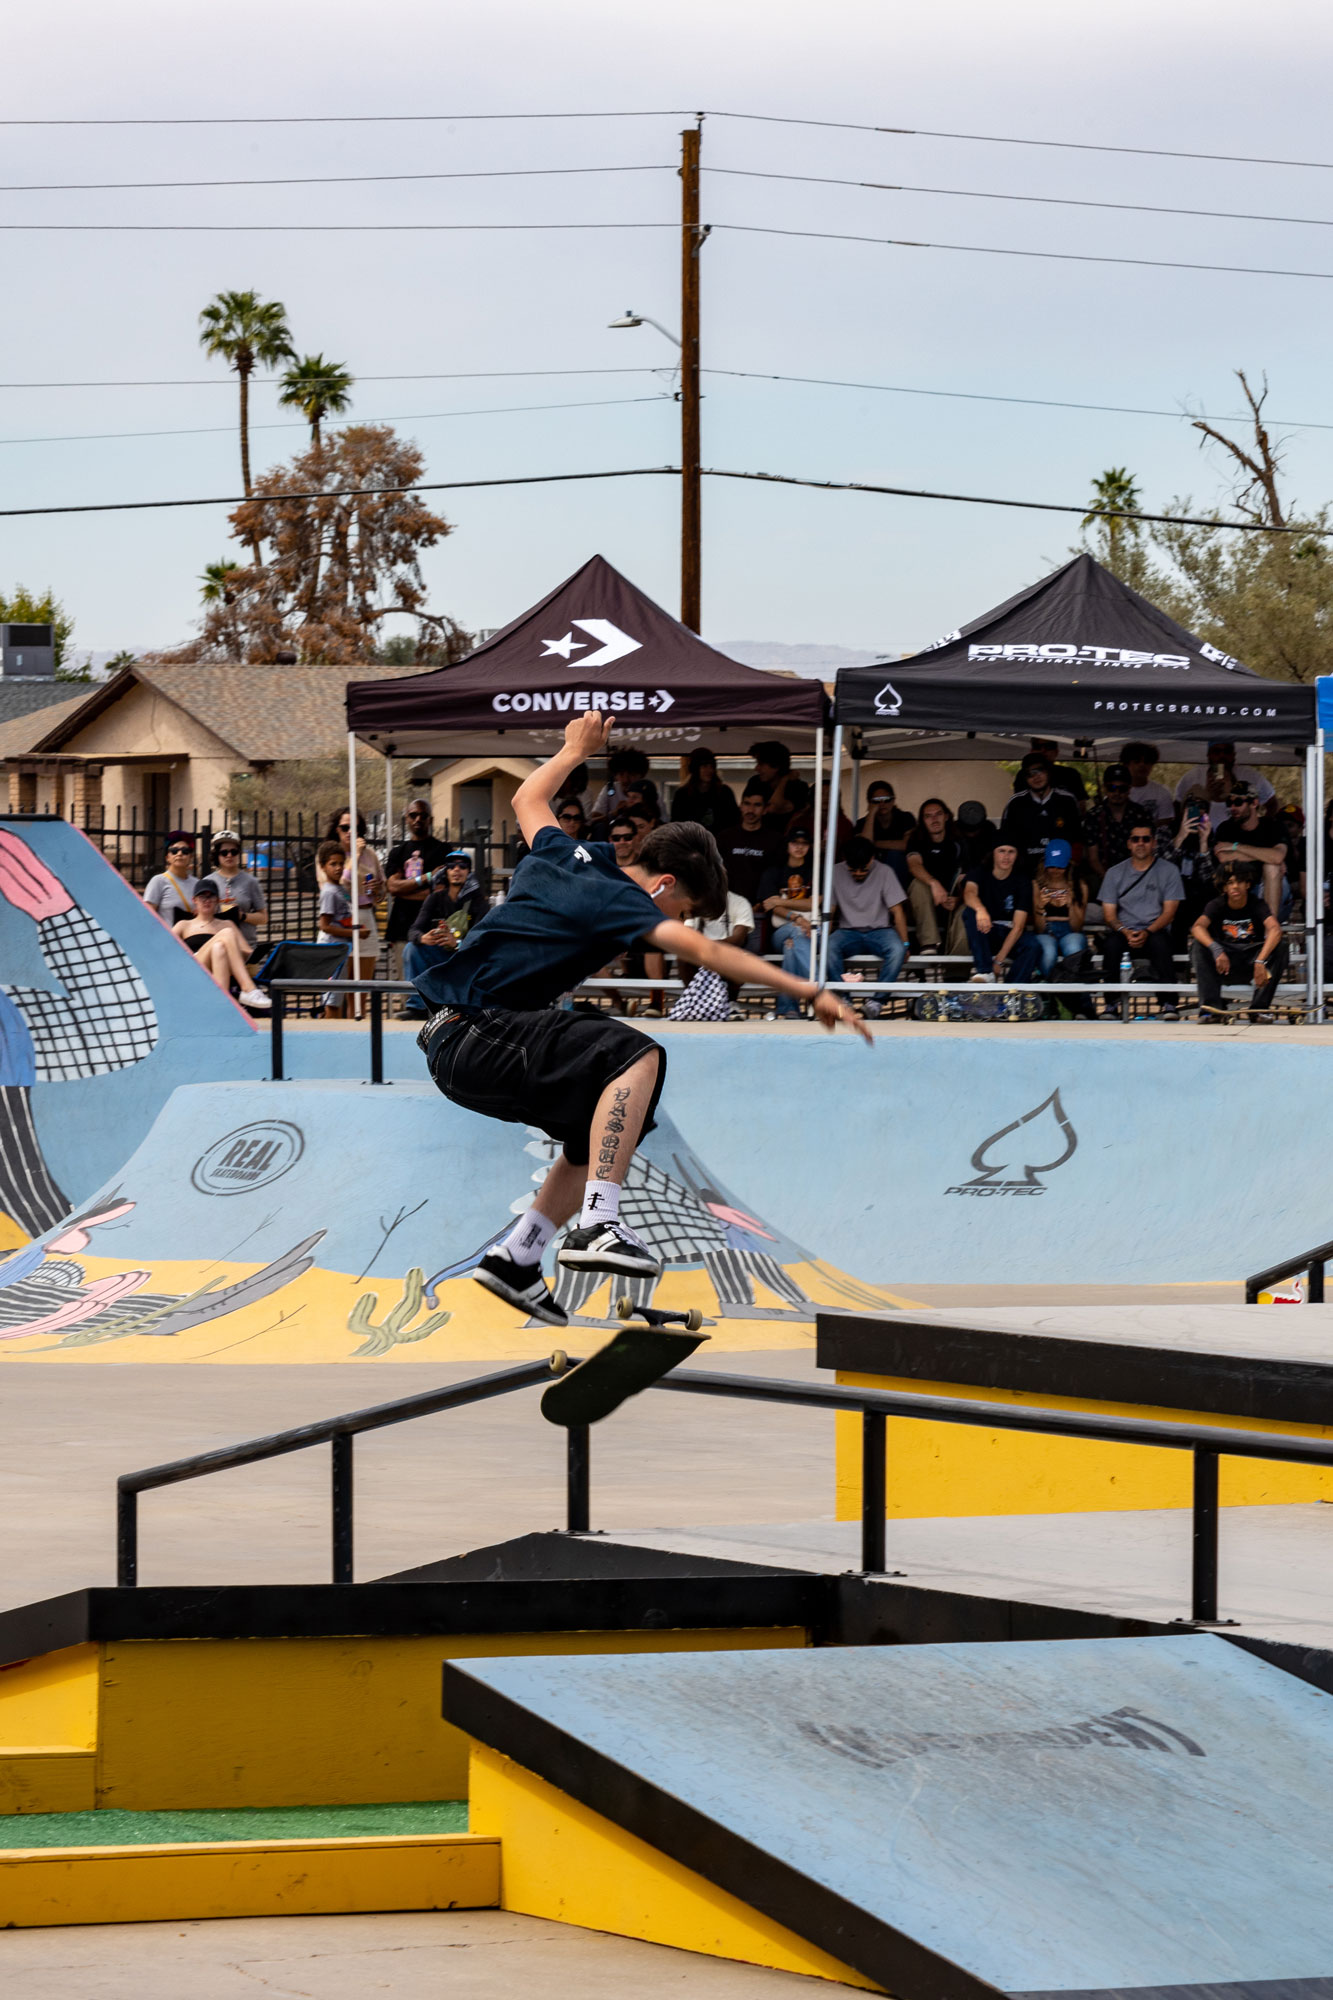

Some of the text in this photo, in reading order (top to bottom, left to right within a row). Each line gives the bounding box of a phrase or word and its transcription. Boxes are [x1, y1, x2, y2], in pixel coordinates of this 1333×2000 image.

[968, 644, 1190, 665] PRO-TEC
[492, 691, 645, 712] CONVERSE
[1094, 701, 1277, 717] PROTECBRAND.COM
[596, 1087, 631, 1180] VASQUE
[217, 1138, 284, 1171] REAL
[943, 1186, 1048, 1197] PRO-TEC
